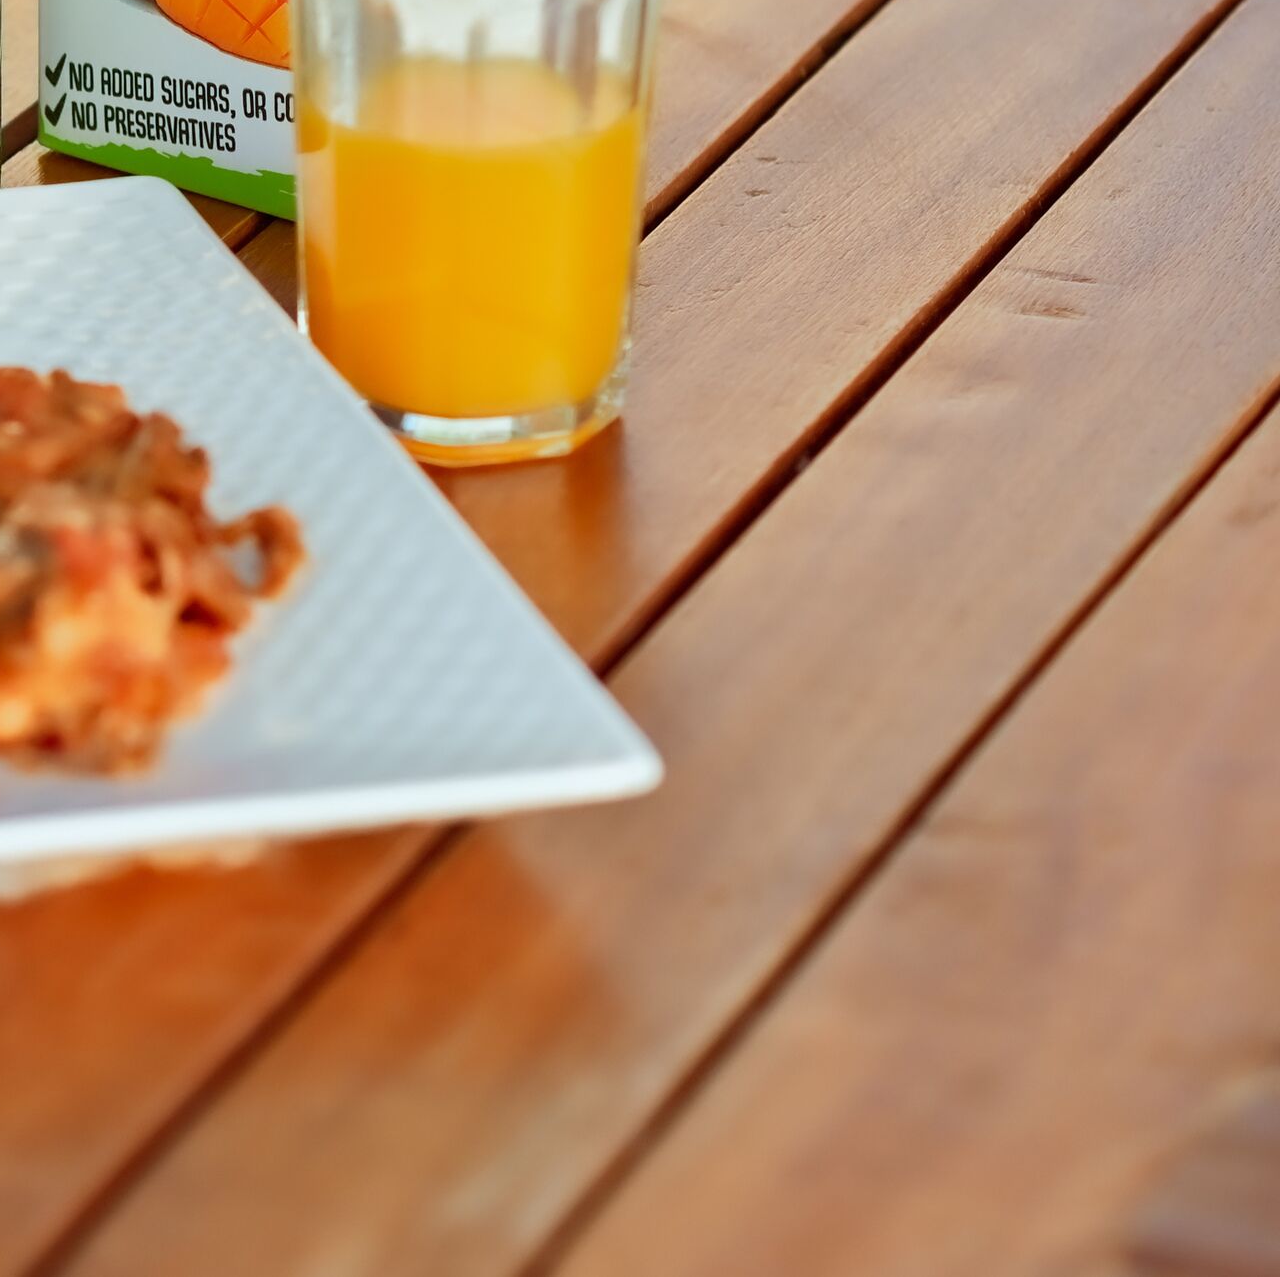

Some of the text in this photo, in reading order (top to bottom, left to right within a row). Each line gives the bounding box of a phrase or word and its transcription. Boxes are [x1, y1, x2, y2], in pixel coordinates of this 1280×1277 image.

[69, 62, 296, 123] NO ADDED SUGARS, OR CO
[71, 101, 236, 153] NO PRESERVATIVES
